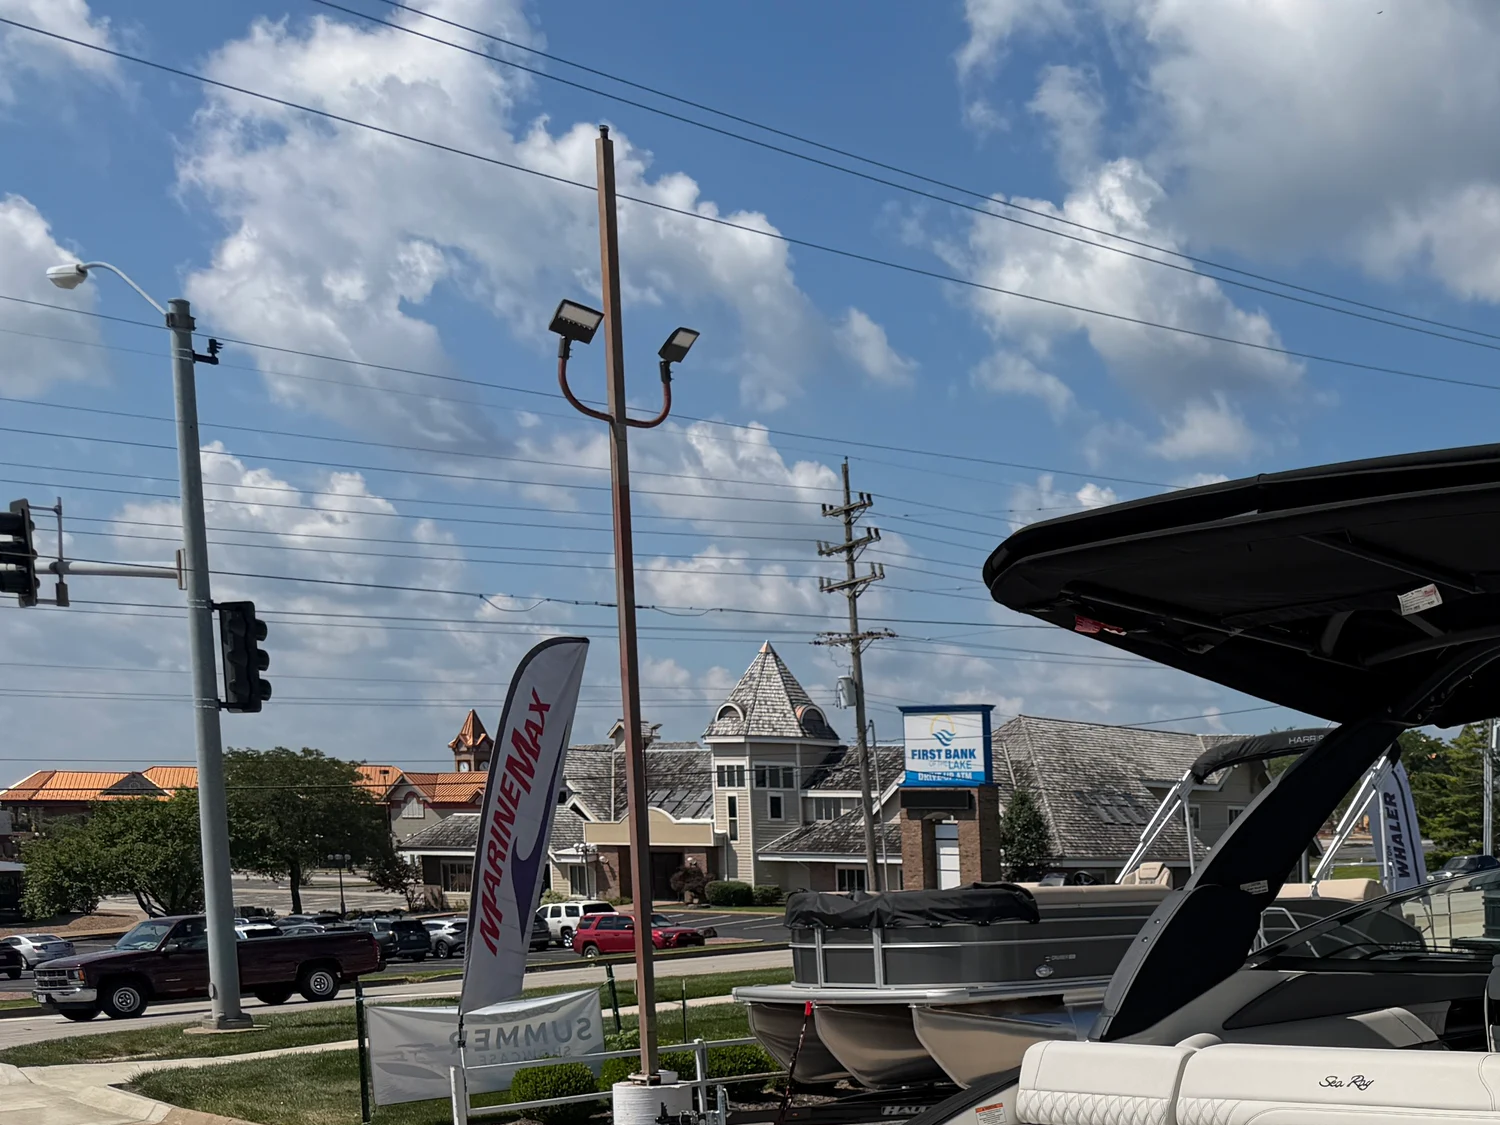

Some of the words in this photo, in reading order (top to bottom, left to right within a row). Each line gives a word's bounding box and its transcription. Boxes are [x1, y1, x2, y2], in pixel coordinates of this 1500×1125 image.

[911, 748, 943, 760] FIRST
[944, 748, 977, 760] BANK
[948, 760, 973, 770] LAKE
[1383, 791, 1411, 878] WHALER
[1318, 1075, 1345, 1089] Sea
[1346, 1074, 1375, 1091] Ray
